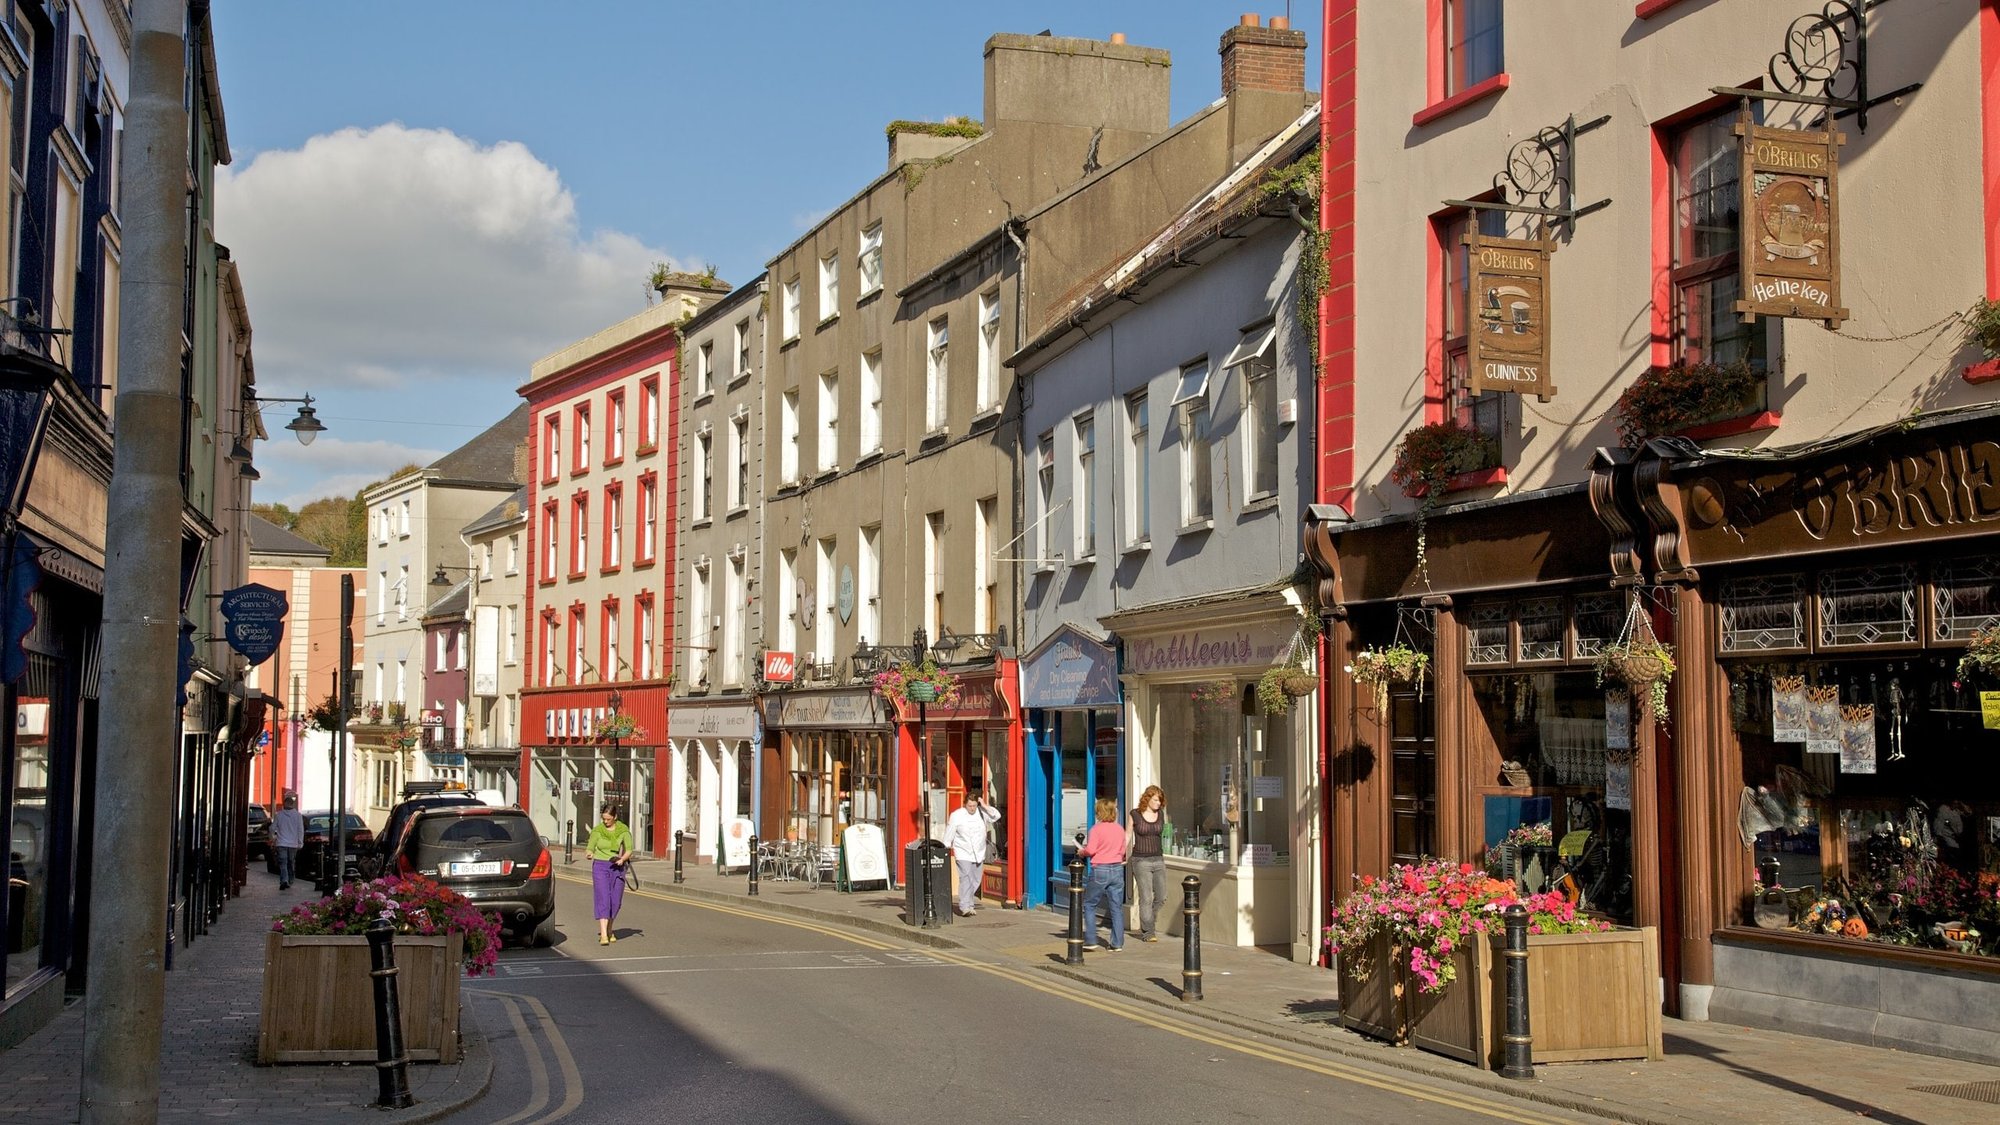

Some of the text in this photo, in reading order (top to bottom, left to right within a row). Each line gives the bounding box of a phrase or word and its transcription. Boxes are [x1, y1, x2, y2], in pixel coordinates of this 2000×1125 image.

[1481, 249, 1535, 271] O'BRIENS
[1753, 278, 1829, 308] Heineken
[1485, 363, 1538, 382] GUINNESS
[226, 591, 284, 609] ARCHITECTURAL
[237, 624, 270, 636] Kennedy
[1133, 631, 1252, 671] Kathleen's
[768, 656, 793, 679] illy
[1049, 669, 1087, 687] Dry Cleaning
[1040, 684, 1099, 702] and Laundry Service
[1840, 705, 1873, 724] WAXIES
